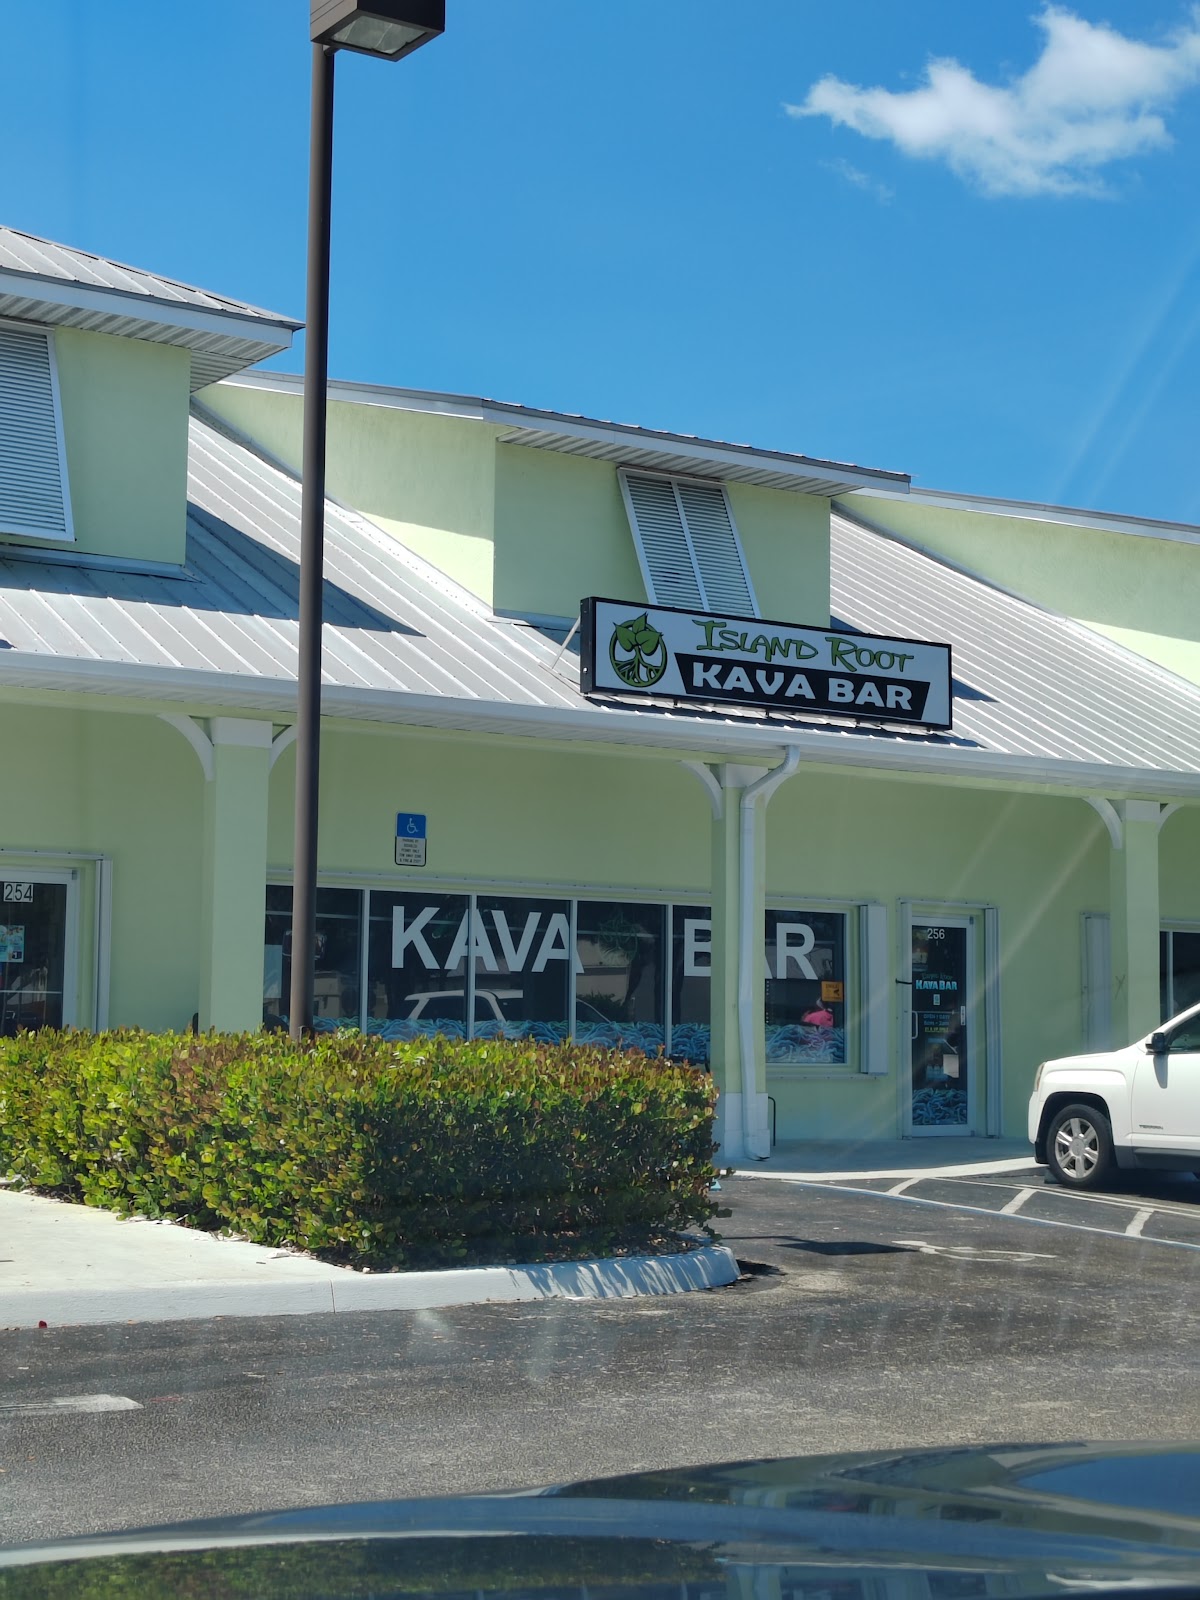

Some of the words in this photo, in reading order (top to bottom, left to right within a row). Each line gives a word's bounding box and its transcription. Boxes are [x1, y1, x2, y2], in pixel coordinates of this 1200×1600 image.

[692, 619, 818, 662] ISLAND
[825, 637, 914, 672] ROOT
[693, 662, 815, 699] KAVA
[828, 678, 913, 711] BAR
[5, 883, 32, 901] 254
[391, 905, 584, 973] KAVA
[684, 918, 818, 980] BR
[927, 928, 945, 939] 256
[915, 979, 938, 990] KAVA
[939, 980, 958, 991] BAR
